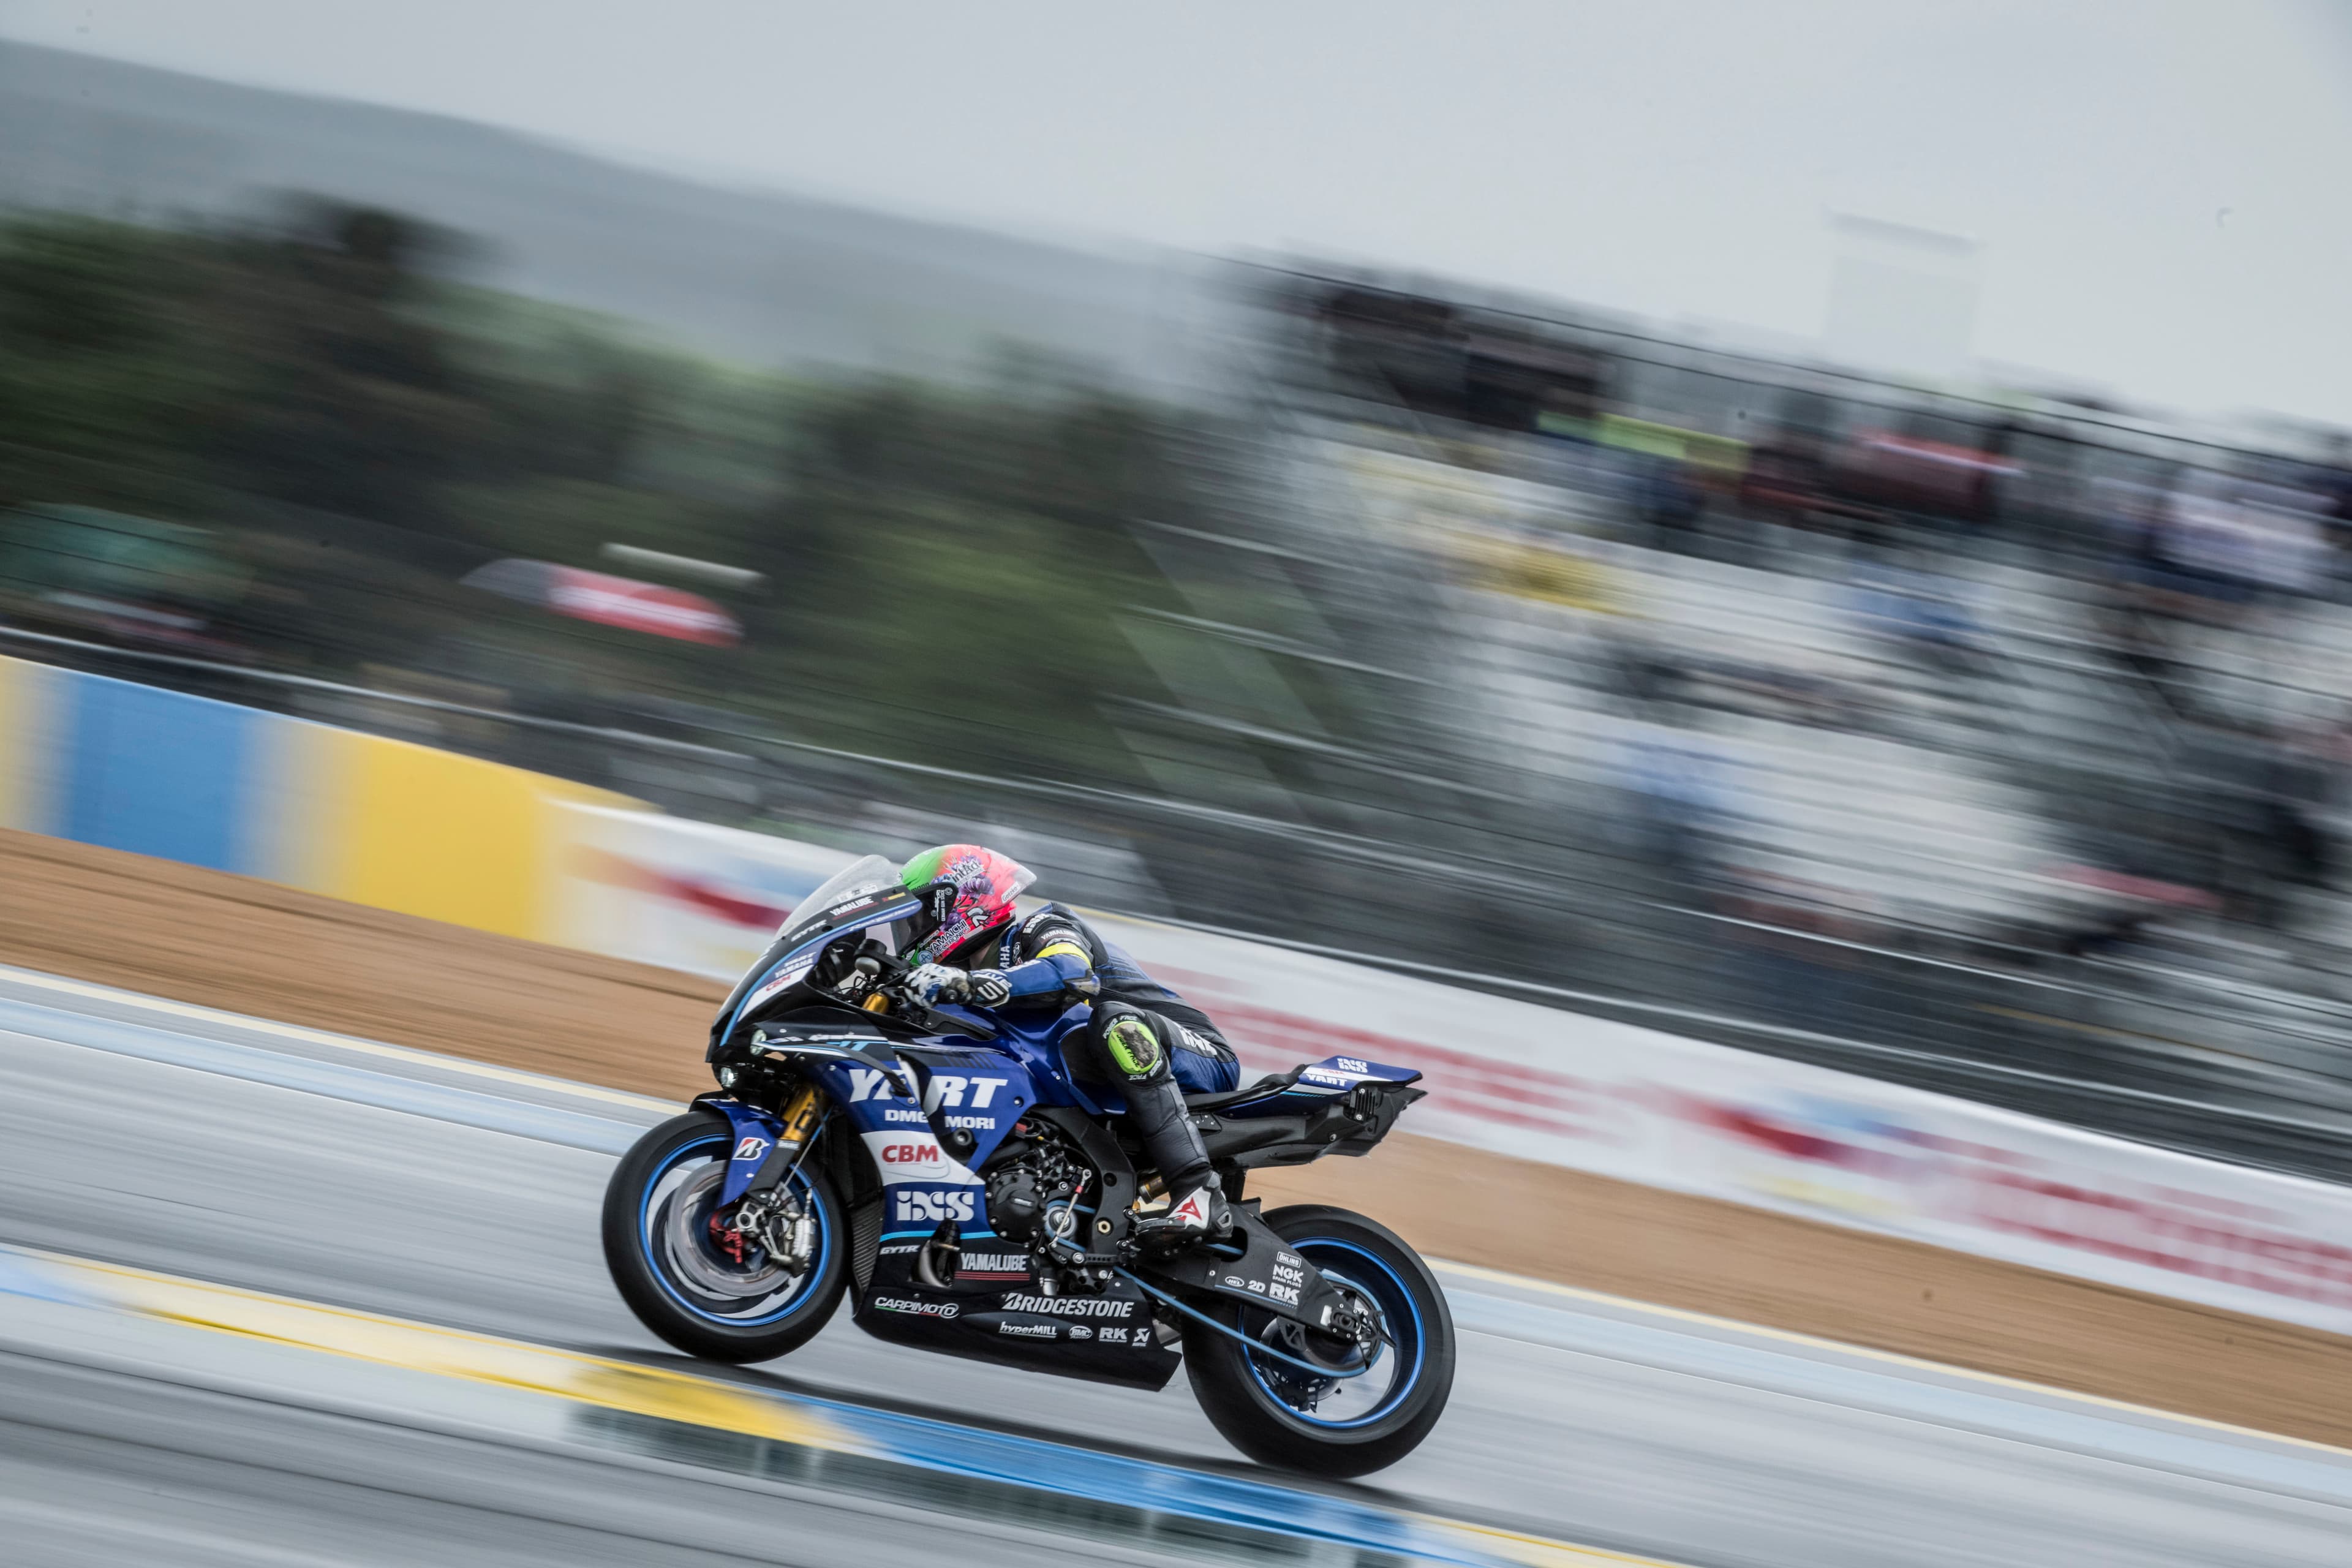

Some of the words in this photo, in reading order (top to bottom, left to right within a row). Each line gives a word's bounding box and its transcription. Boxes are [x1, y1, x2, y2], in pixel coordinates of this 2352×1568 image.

[829, 895, 874, 916] YAMALUBE
[925, 919, 968, 952] YAMAICHI
[933, 927, 971, 957] ELECTRONICS
[1000, 946, 1010, 970] AHA
[945, 1116, 995, 1129] MORI
[882, 1145, 939, 1163] CBM
[879, 1245, 921, 1255] GYTR
[960, 1253, 1030, 1272] YAMALUBE
[1273, 1264, 1304, 1283] NGK
[1247, 1280, 1266, 1293] 2D
[1270, 1282, 1300, 1302] RK
[1001, 1292, 1134, 1317] BRIDGESTONE
[1000, 1321, 1057, 1335] hyperMILL
[1099, 1327, 1129, 1340] RK
